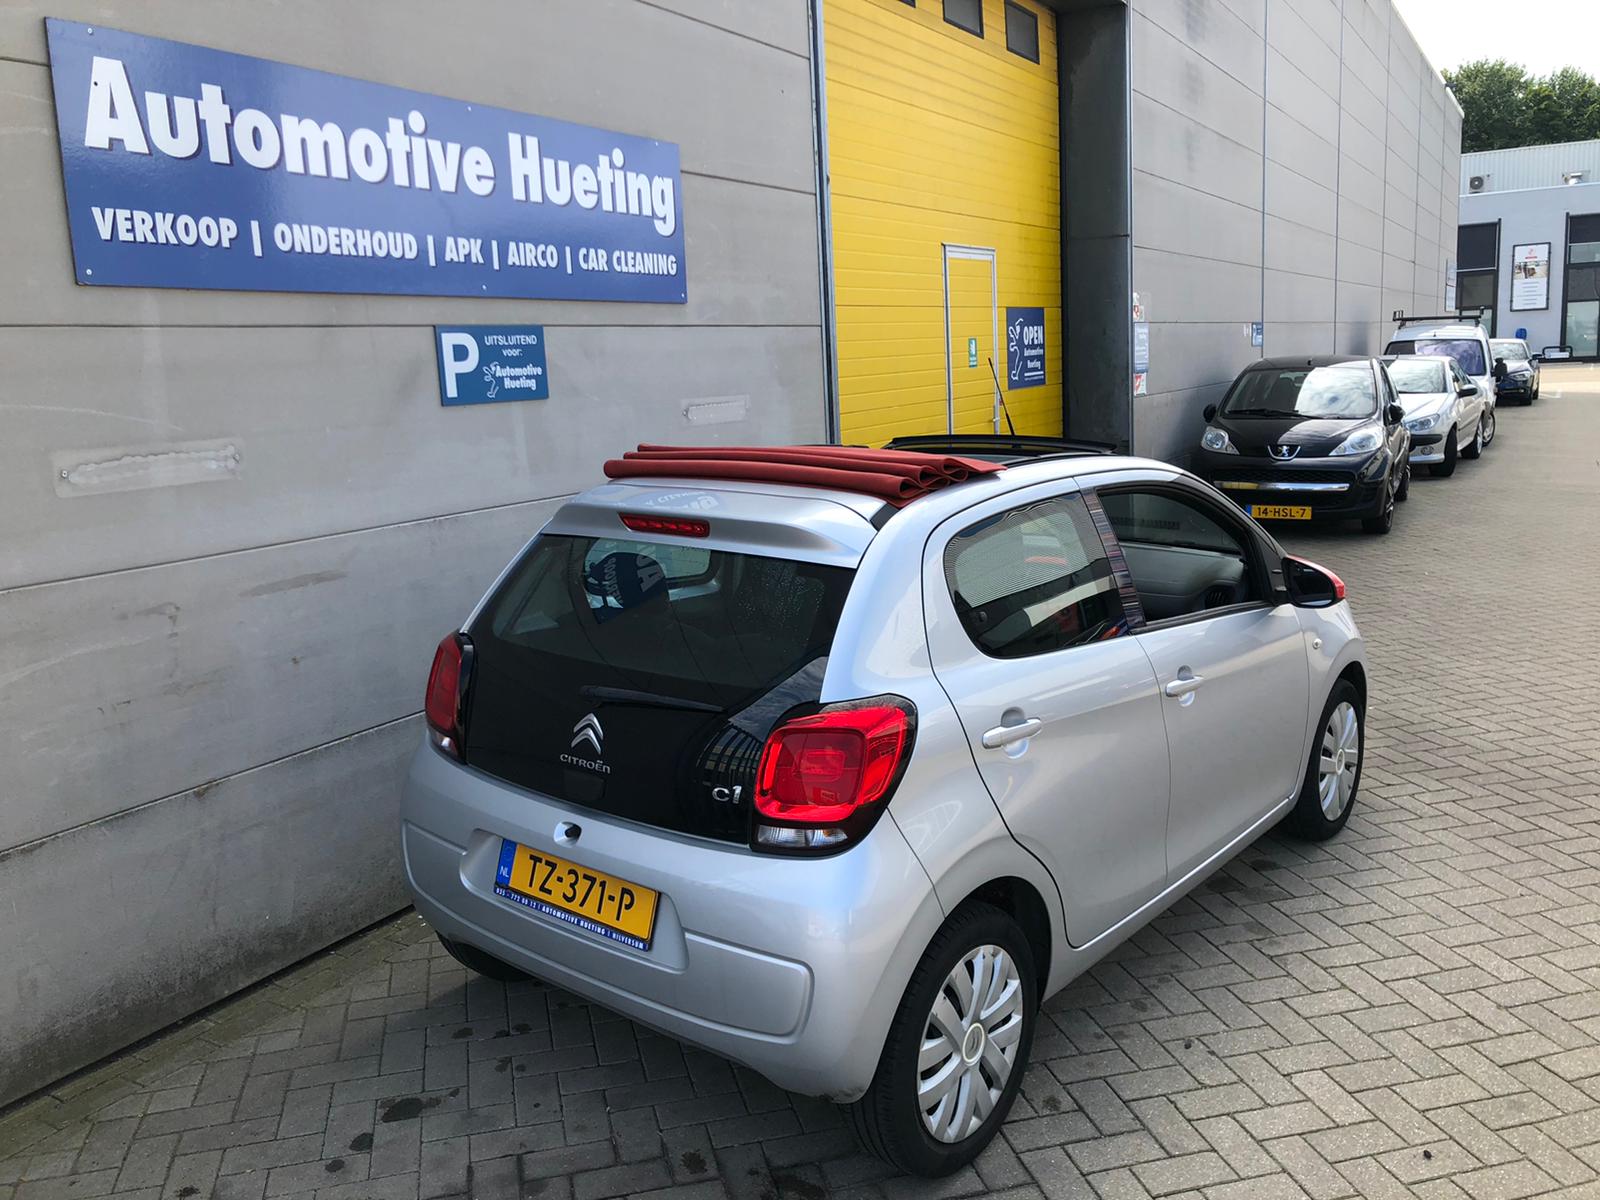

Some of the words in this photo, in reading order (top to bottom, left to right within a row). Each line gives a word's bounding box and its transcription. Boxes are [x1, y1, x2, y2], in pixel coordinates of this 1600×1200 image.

[85, 56, 495, 197] Automotive
[508, 132, 676, 237] Hueting
[91, 206, 238, 248] VERKOOP
[274, 223, 418, 260] ONDERHOUD
[445, 236, 484, 264] APK
[508, 241, 559, 268] AIRCO
[578, 247, 608, 272] CAR
[612, 250, 677, 276] CLEANING
[484, 335, 537, 345] UITSLUITEND
[1023, 325, 1043, 345] OPEN
[502, 348, 523, 357] voor:
[441, 332, 479, 398] P
[495, 364, 542, 377] Automotive
[504, 377, 536, 390] Hueting
[1257, 507, 1306, 518] 14-HSL-7
[560, 753, 611, 774] CITROËN
[712, 785, 742, 804] C1
[499, 865, 509, 878] NL
[528, 854, 635, 921] TZ-371-P
